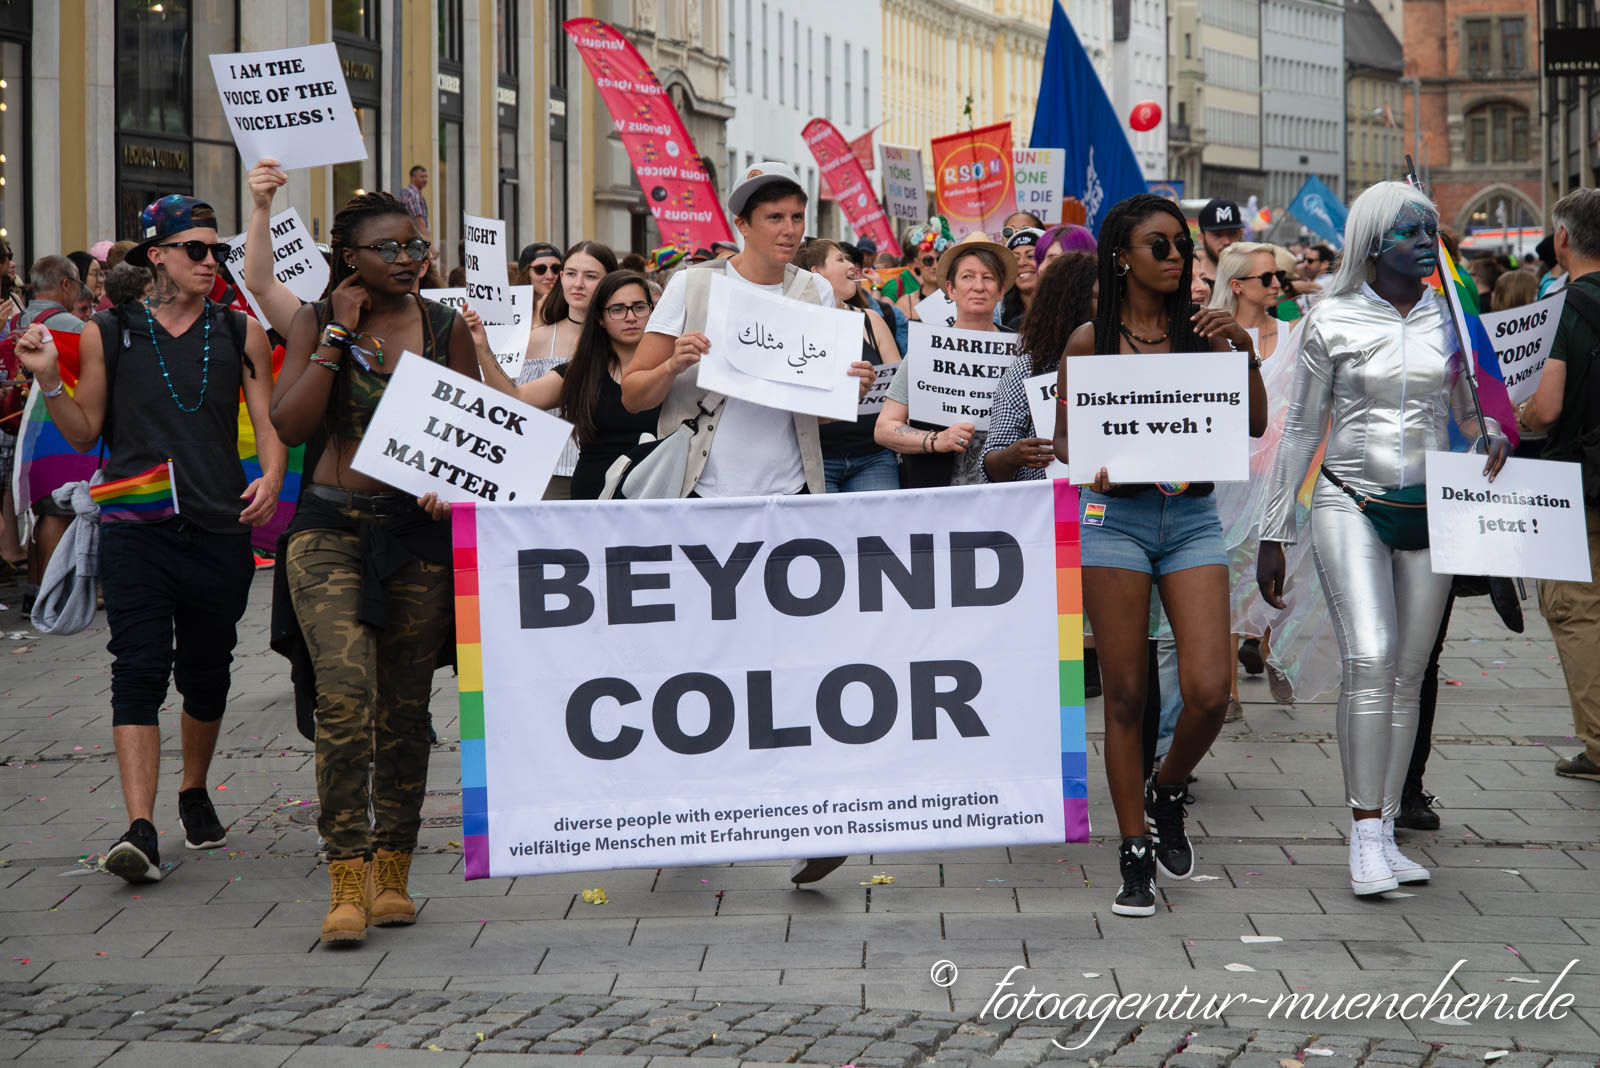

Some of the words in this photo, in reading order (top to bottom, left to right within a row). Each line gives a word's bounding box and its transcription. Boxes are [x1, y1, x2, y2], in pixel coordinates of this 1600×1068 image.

[230, 65, 237, 79] I
[240, 63, 263, 79] AM
[265, 58, 305, 76] THE
[223, 90, 263, 105] VOICE
[266, 87, 290, 103] OF
[295, 81, 337, 99] THE
[234, 109, 323, 131] VOICELESS
[327, 107, 335, 121] !
[1014, 151, 1052, 164] UNTE
[889, 164, 912, 181] TÖNE
[1014, 168, 1048, 184] ÖNE
[904, 186, 918, 200] DIE
[1031, 190, 1053, 202] DIE
[271, 217, 296, 239] MIT
[468, 226, 497, 245] FIGHT
[274, 238, 304, 262] ICHT
[276, 263, 305, 284] UNS
[305, 259, 312, 269] !
[497, 286, 502, 302] !
[1495, 309, 1548, 338] SOMOS
[738, 321, 784, 350] مثلك
[787, 334, 827, 374] مثلي
[917, 380, 965, 398] Grenzen
[1076, 390, 1240, 406] Diskriminierung
[432, 380, 527, 436] BLACK
[942, 402, 957, 414] im
[1102, 419, 1139, 436] tut
[1146, 417, 1198, 434] weh
[1206, 416, 1212, 433] !
[423, 416, 507, 465] LIVES
[382, 438, 499, 502] MATTER
[1442, 487, 1571, 509] Dekolonisation
[1478, 515, 1527, 535] jetzt
[1532, 518, 1539, 534] !
[518, 530, 1024, 629] BEYOND
[565, 659, 990, 761] COLOR
[553, 817, 612, 832] diverse
[616, 812, 672, 831] people
[675, 807, 710, 824] with
[714, 803, 809, 823] experiences
[812, 800, 830, 815] of
[832, 796, 883, 813] racism
[887, 793, 917, 809] and
[921, 791, 999, 812] migration
[509, 839, 591, 857] vielfältige
[596, 833, 676, 851] Menschen
[680, 830, 707, 845] mit
[710, 824, 810, 843] Erfahrungen
[814, 822, 843, 836] von
[848, 815, 928, 834] Rassismus
[932, 813, 963, 829] und
[966, 810, 1044, 830] Migration
